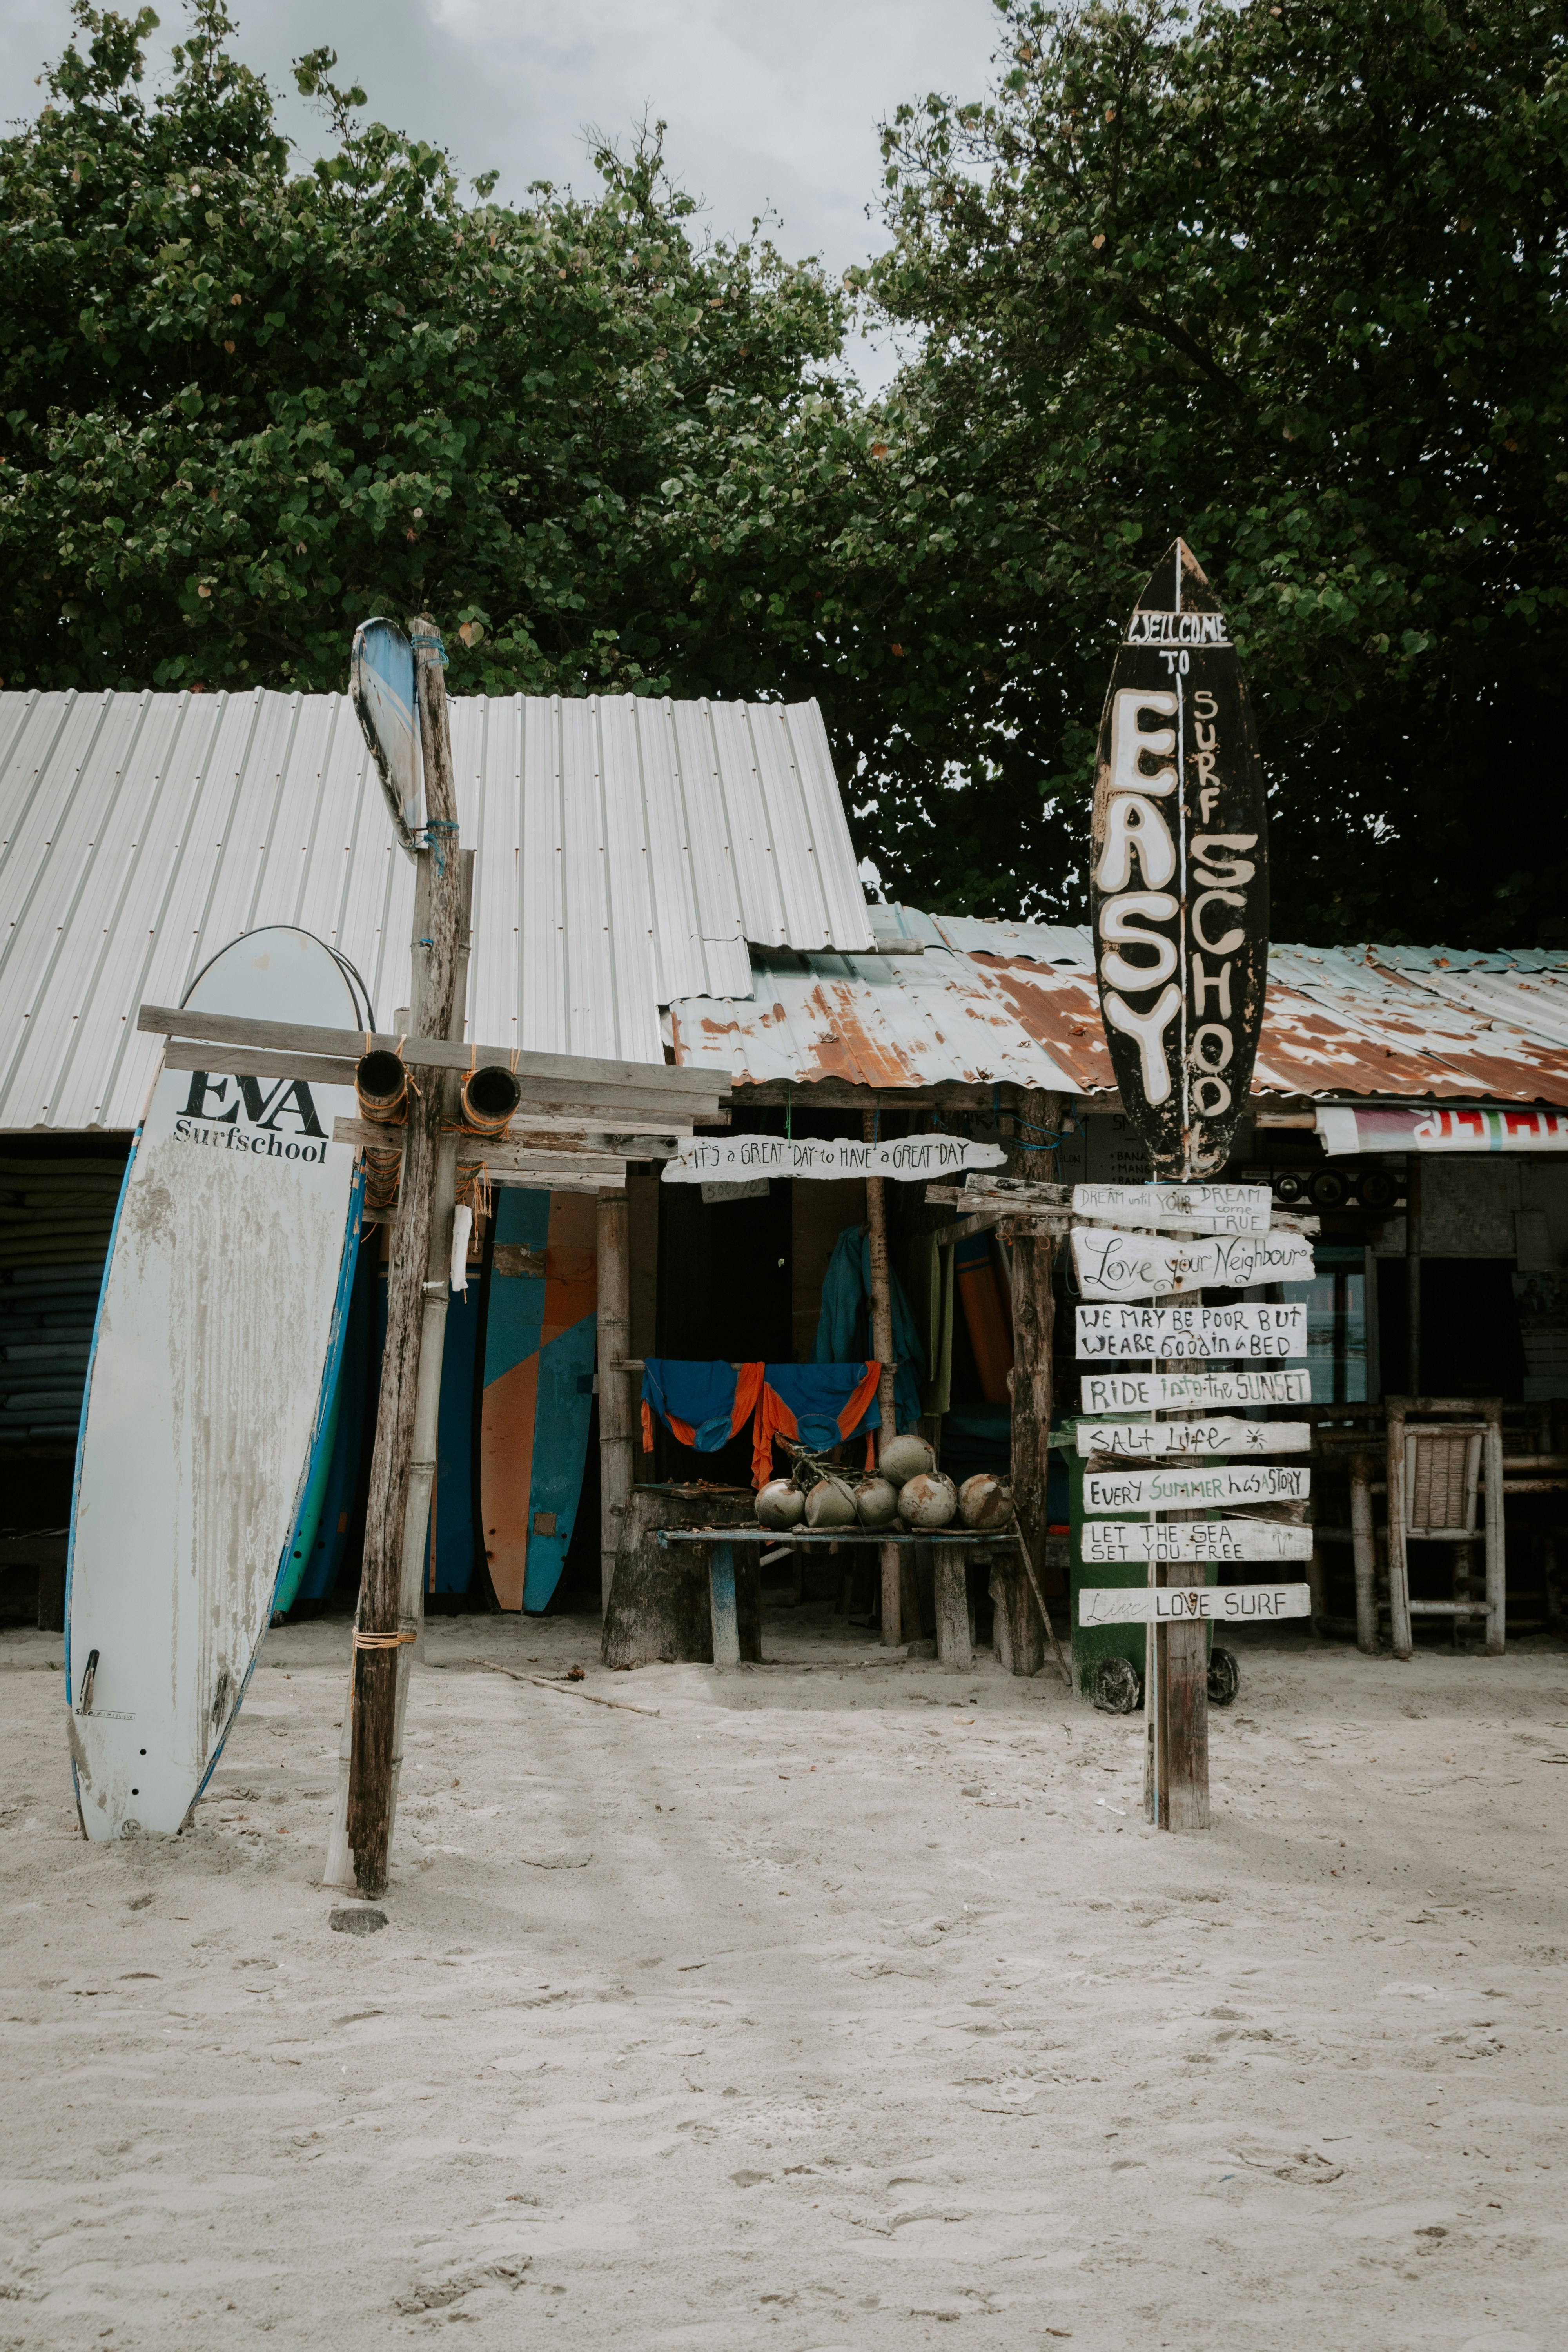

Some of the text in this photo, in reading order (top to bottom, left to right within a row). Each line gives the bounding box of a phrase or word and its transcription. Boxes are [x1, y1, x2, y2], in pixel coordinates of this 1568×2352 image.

[1128, 614, 1228, 644] WELLCOME
[1159, 650, 1190, 674] TO
[1194, 691, 1220, 824] SURF
[1097, 688, 1182, 1105] EASY
[176, 1071, 329, 1139] EVA
[173, 1119, 327, 1164] Surfschool
[694, 1142, 970, 1169] IT'S a GREAT DAY to HAVE a GREAT DAY
[1080, 1187, 1260, 1214] DREAM until YOUR DREAM
[1216, 1205, 1252, 1215] come
[1212, 1215, 1263, 1231] TRUE
[1084, 1236, 1307, 1292] Love your Neighbour
[1081, 1310, 1111, 1328] WE
[1121, 1310, 1166, 1329] MAY
[1173, 1311, 1192, 1331] BE
[1203, 1310, 1248, 1330] POOR
[1250, 1335, 1290, 1356] BED
[1161, 1378, 1203, 1400] into
[1238, 1373, 1305, 1401] SUNSET
[1091, 1480, 1142, 1506] EVERY
[1149, 1475, 1225, 1501] SUMMER
[1269, 1468, 1301, 1495] STORY
[1092, 1525, 1232, 1543] LET THE SEA
[1091, 1544, 1245, 1561] SET YOU FREE
[1157, 1594, 1211, 1617] LOVE
[1225, 1593, 1287, 1616] SURF
